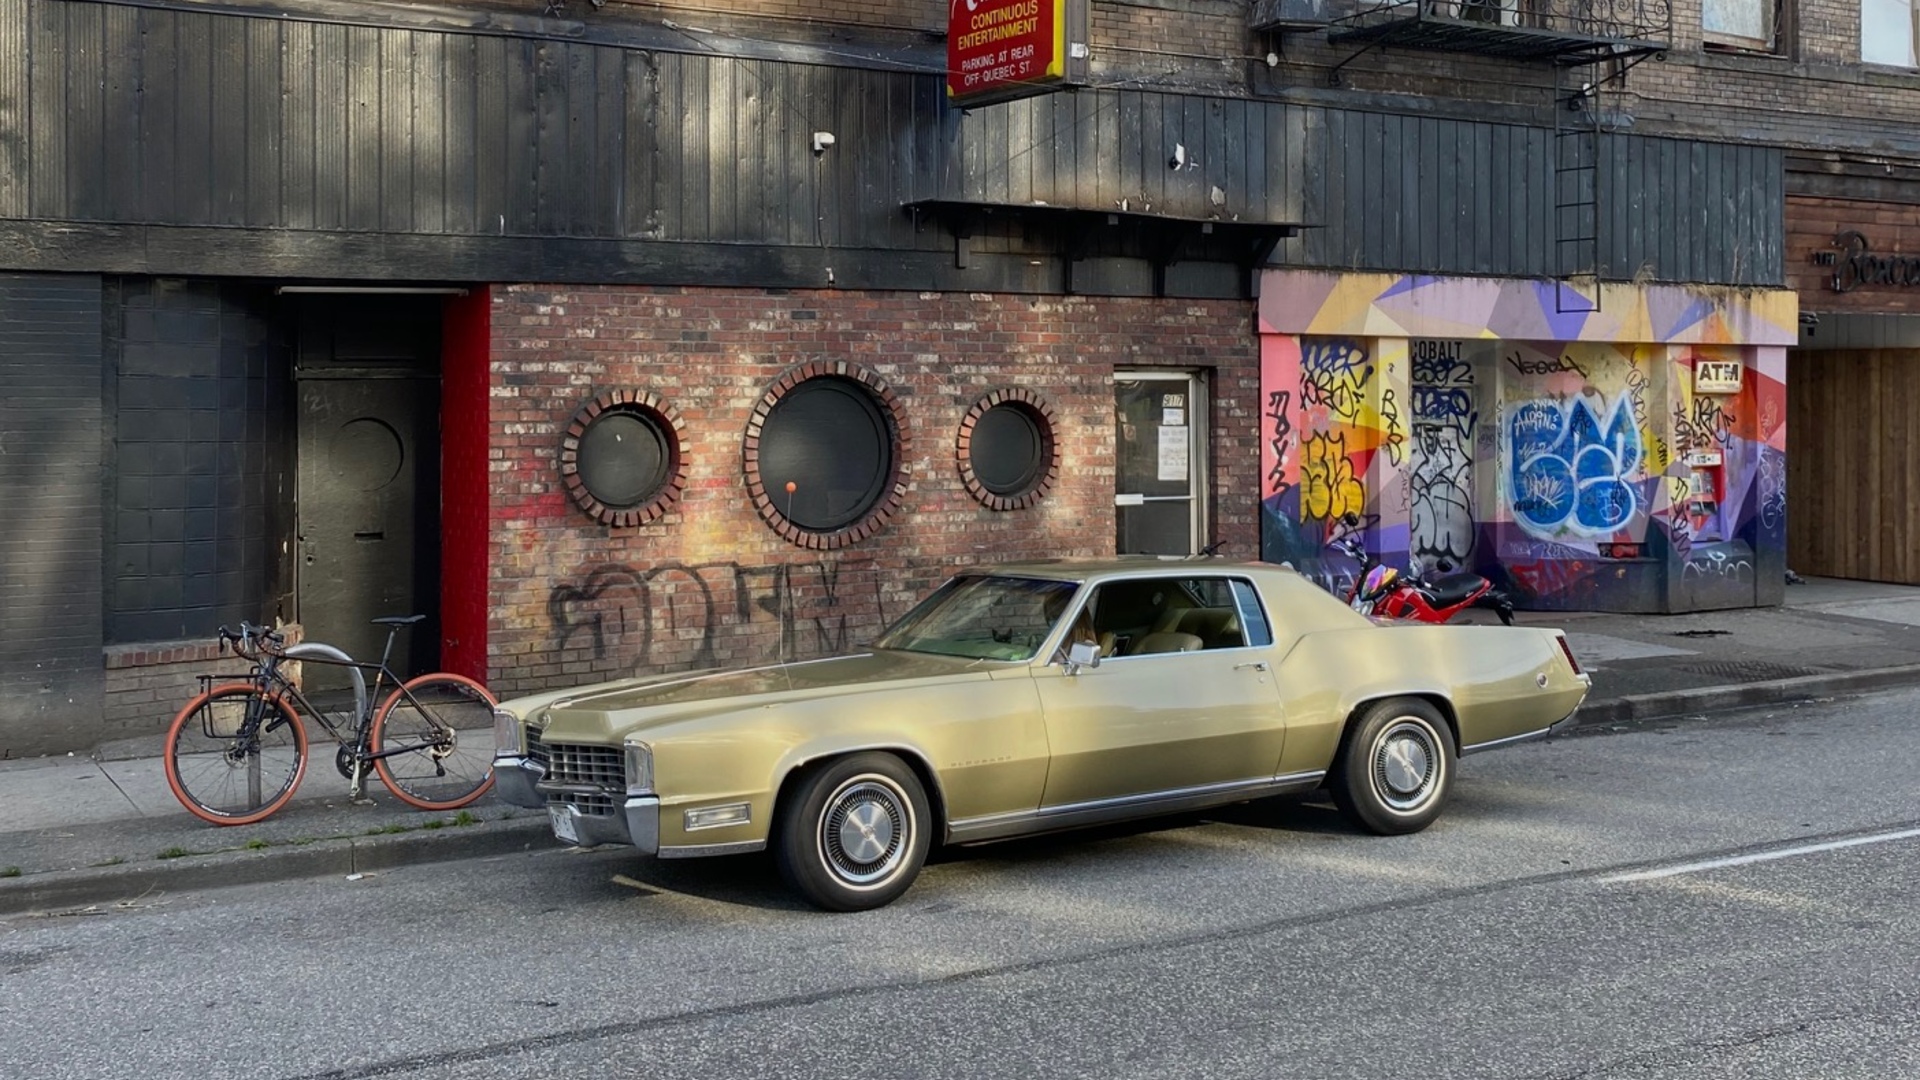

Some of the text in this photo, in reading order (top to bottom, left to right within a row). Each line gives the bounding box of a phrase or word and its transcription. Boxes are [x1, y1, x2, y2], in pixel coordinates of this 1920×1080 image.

[971, 0, 1038, 30] CONTINUOUS
[958, 17, 1038, 50] ENTERTAINMENT
[962, 44, 1034, 71] PARKING AT REAR
[964, 72, 980, 86] OFF
[982, 64, 1016, 82] QUEBEC
[1698, 363, 1740, 382] ATM
